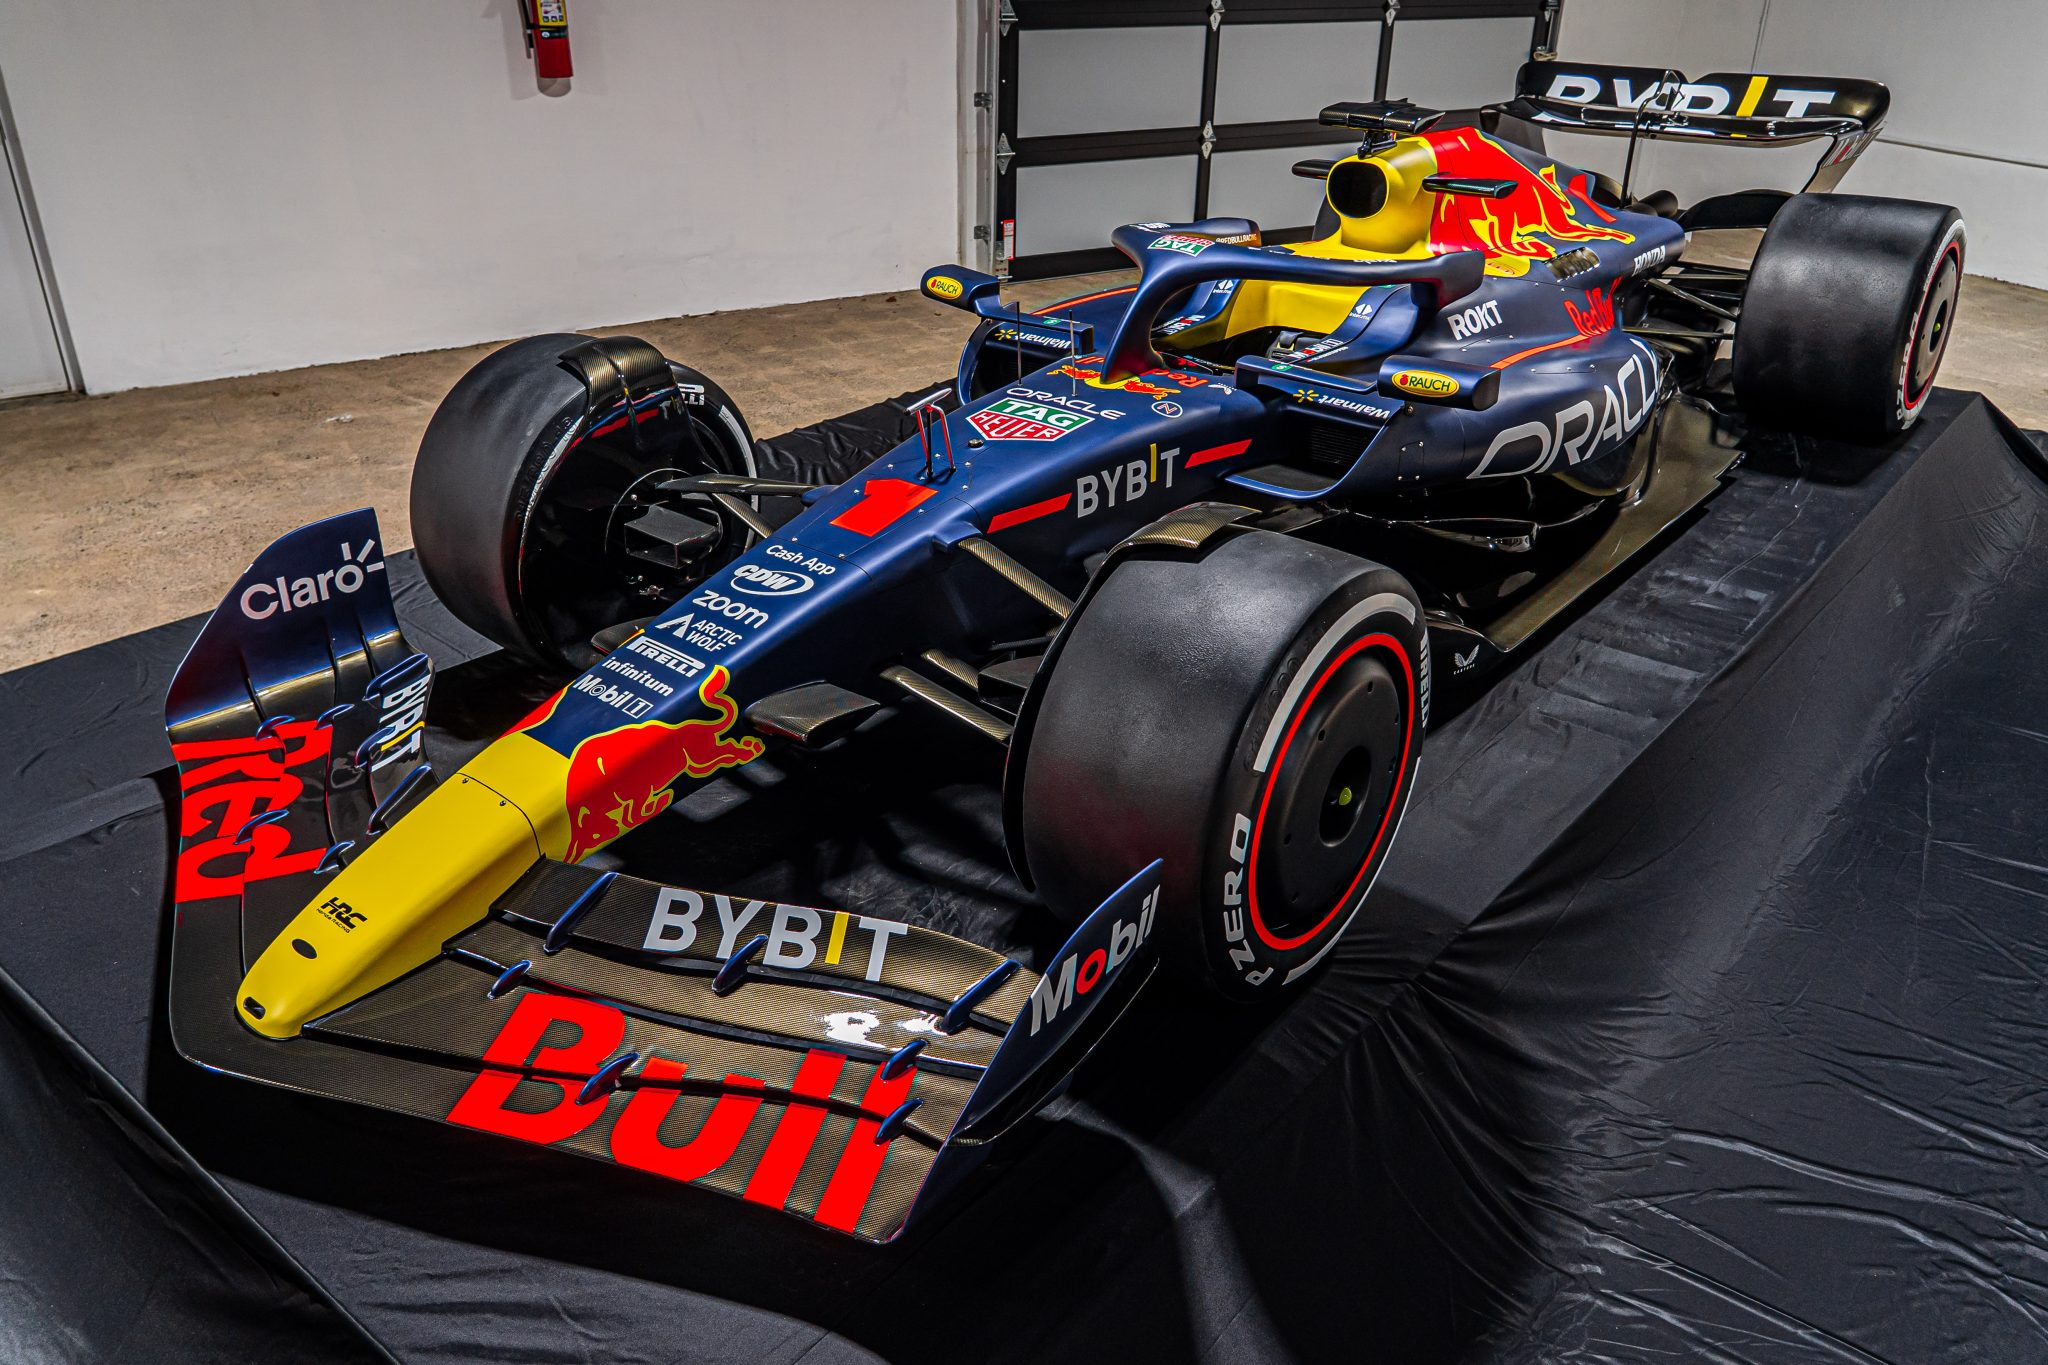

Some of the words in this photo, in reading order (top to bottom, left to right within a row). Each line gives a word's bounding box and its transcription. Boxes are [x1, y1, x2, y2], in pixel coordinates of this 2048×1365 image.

[1154, 240, 1196, 253] TAG
[1632, 245, 1666, 276] HONDA
[936, 280, 959, 295] RAUCH
[1447, 300, 1503, 341] ROKT
[1014, 331, 1072, 349] Walmart
[1409, 374, 1451, 394] RAUCH
[1001, 400, 1081, 428] TAG
[1006, 387, 1127, 421] ORACLE
[1318, 394, 1391, 419] Walmart
[974, 411, 1062, 439] HEUER
[1075, 443, 1182, 519] BYBIT
[830, 478, 939, 537] 1
[766, 544, 804, 564] Cash
[801, 557, 836, 575] App
[240, 557, 366, 620] Claro
[733, 564, 798, 590] CDW
[692, 589, 769, 629] zoom
[685, 630, 727, 652] WOLF
[691, 619, 743, 646] ARCTIC
[626, 635, 706, 678] PIRELLI
[573, 673, 635, 709] Mobil
[602, 657, 674, 697] infinitum
[172, 720, 334, 904] Red
[320, 896, 369, 930] HRC
[643, 887, 909, 982] BYBIT
[1030, 884, 1162, 1037] Mobil
[446, 992, 919, 1234] Bull
